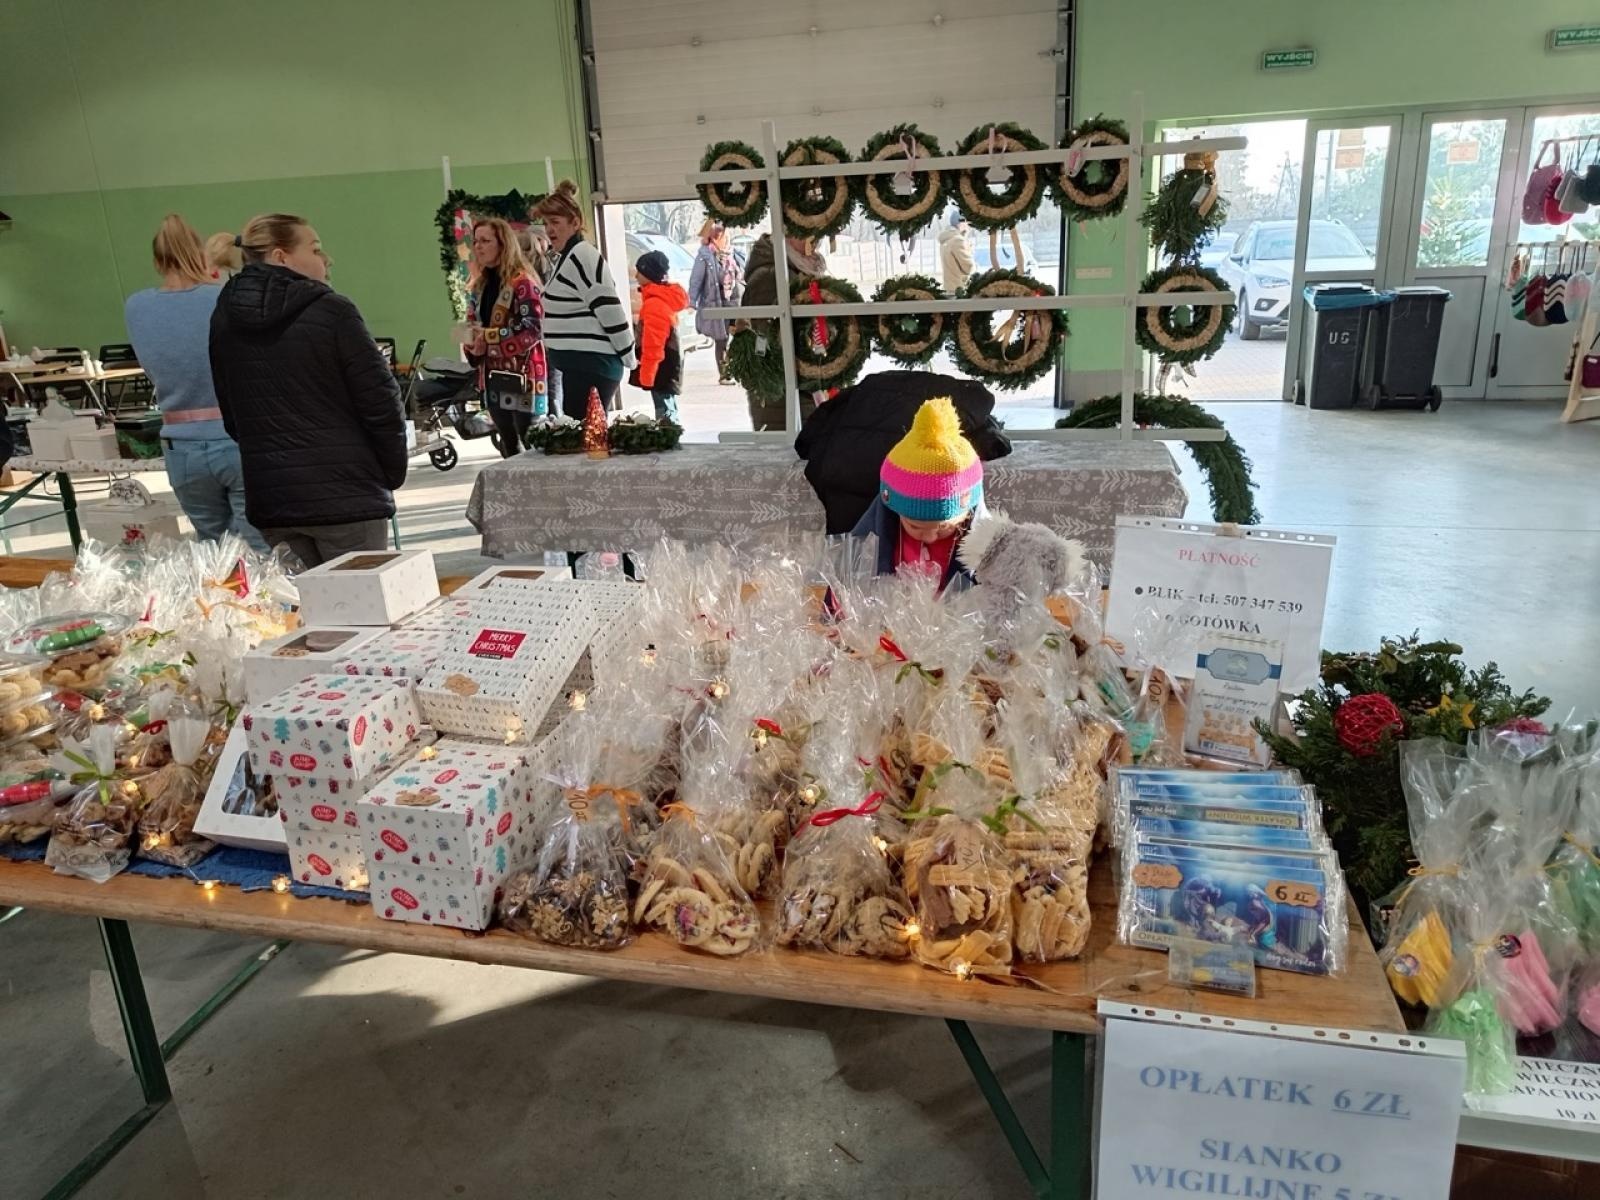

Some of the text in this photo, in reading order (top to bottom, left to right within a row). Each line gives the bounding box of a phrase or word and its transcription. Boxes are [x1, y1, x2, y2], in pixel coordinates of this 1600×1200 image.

[1148, 585, 1184, 600] BLIK
[1199, 593, 1219, 605] tel.
[1224, 594, 1247, 607] 507
[1250, 598, 1275, 611] 347
[1278, 601, 1303, 614] 539
[1179, 614, 1262, 635] GOTÓWKA
[474, 641, 517, 653] CHRISTMAS
[489, 632, 516, 642] MERRY
[1275, 885, 1288, 900] 6
[1140, 1065, 1411, 1117] OPŁATEK 6 ZŁ
[1557, 1108, 1576, 1119] 10
[1200, 1138, 1342, 1174] SIANKO
[1131, 1164, 1322, 1200] WIGILIJNE
